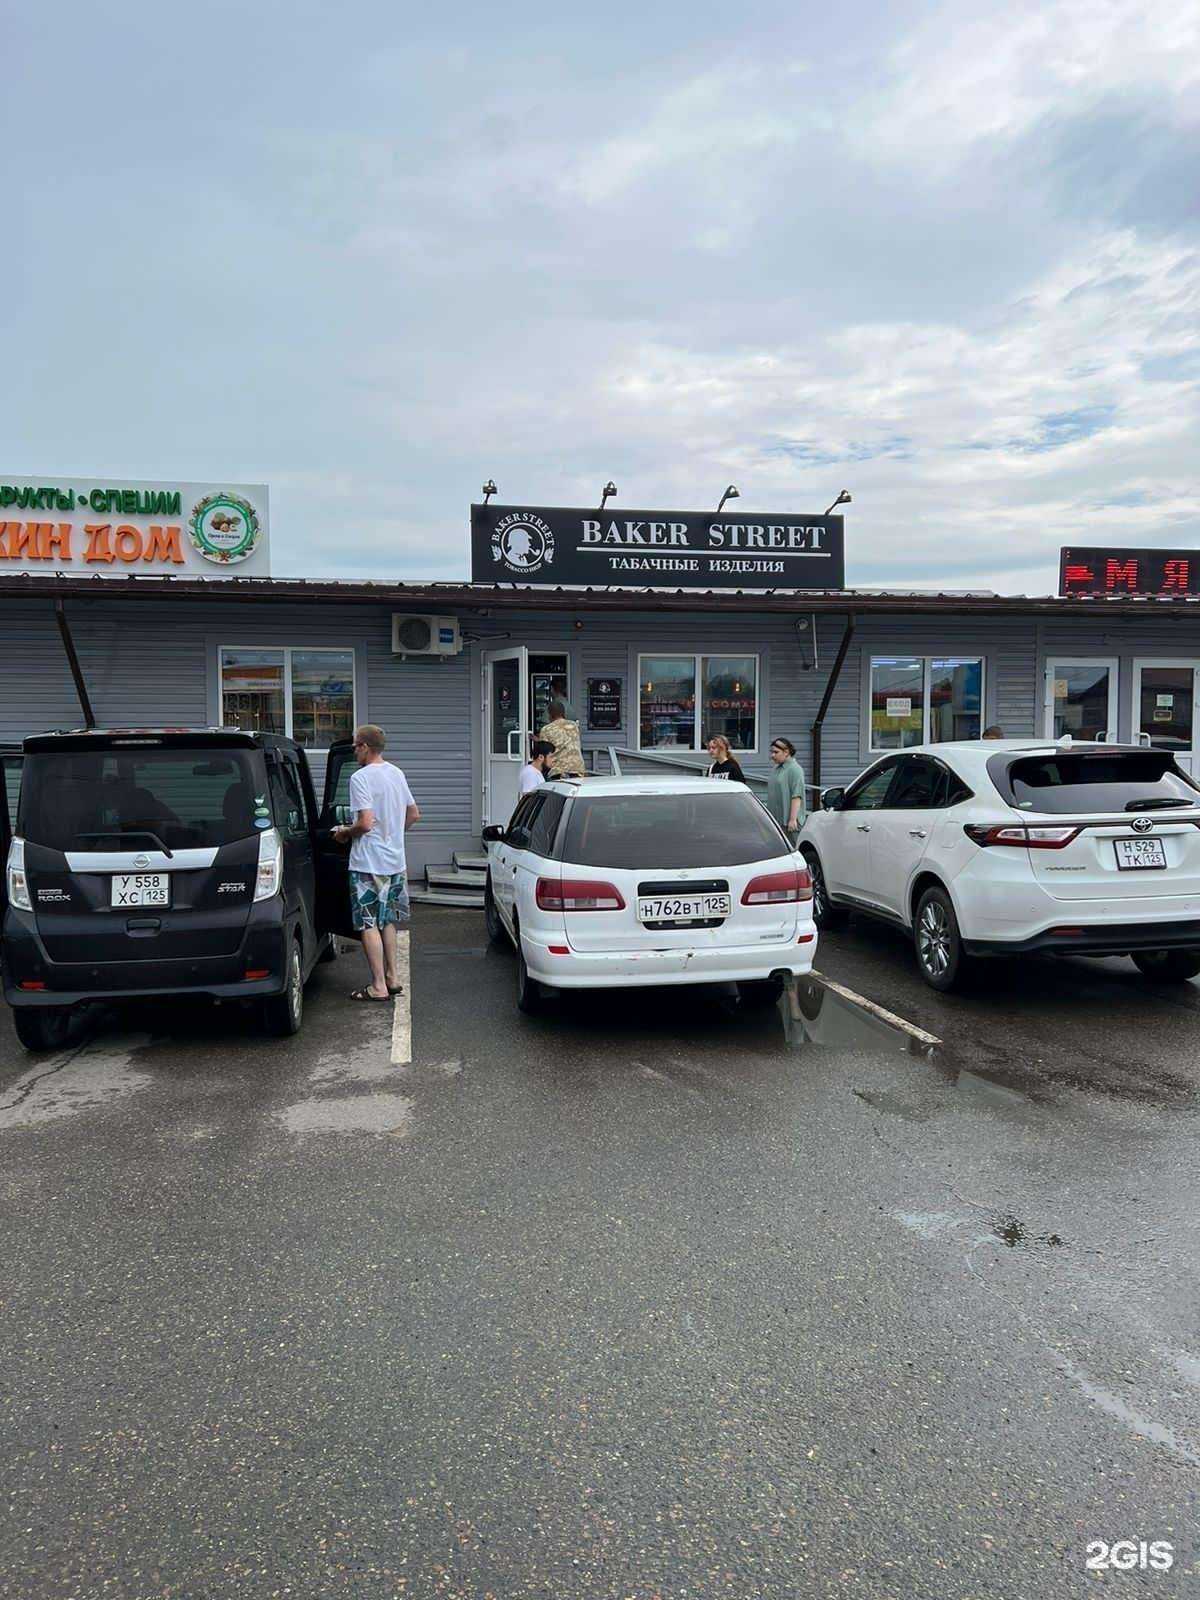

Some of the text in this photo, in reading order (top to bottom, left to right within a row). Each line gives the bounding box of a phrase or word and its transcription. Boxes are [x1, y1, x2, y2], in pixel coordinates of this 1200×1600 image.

[0, 486, 182, 515] РУКТЫ СПЕЦИИ
[490, 512, 555, 547] BAKER STREET
[581, 520, 826, 550] BAKER STREET
[83, 523, 185, 563] ДОМ
[609, 556, 785, 573] ТАБАЧНЫЕ ИЗДЕЛИЯ
[1135, 841, 1155, 852] 529
[1125, 854, 1161, 866] ТК 125
[135, 876, 160, 888] 558
[118, 890, 166, 904] ХС 125
[704, 897, 726, 910] 125
